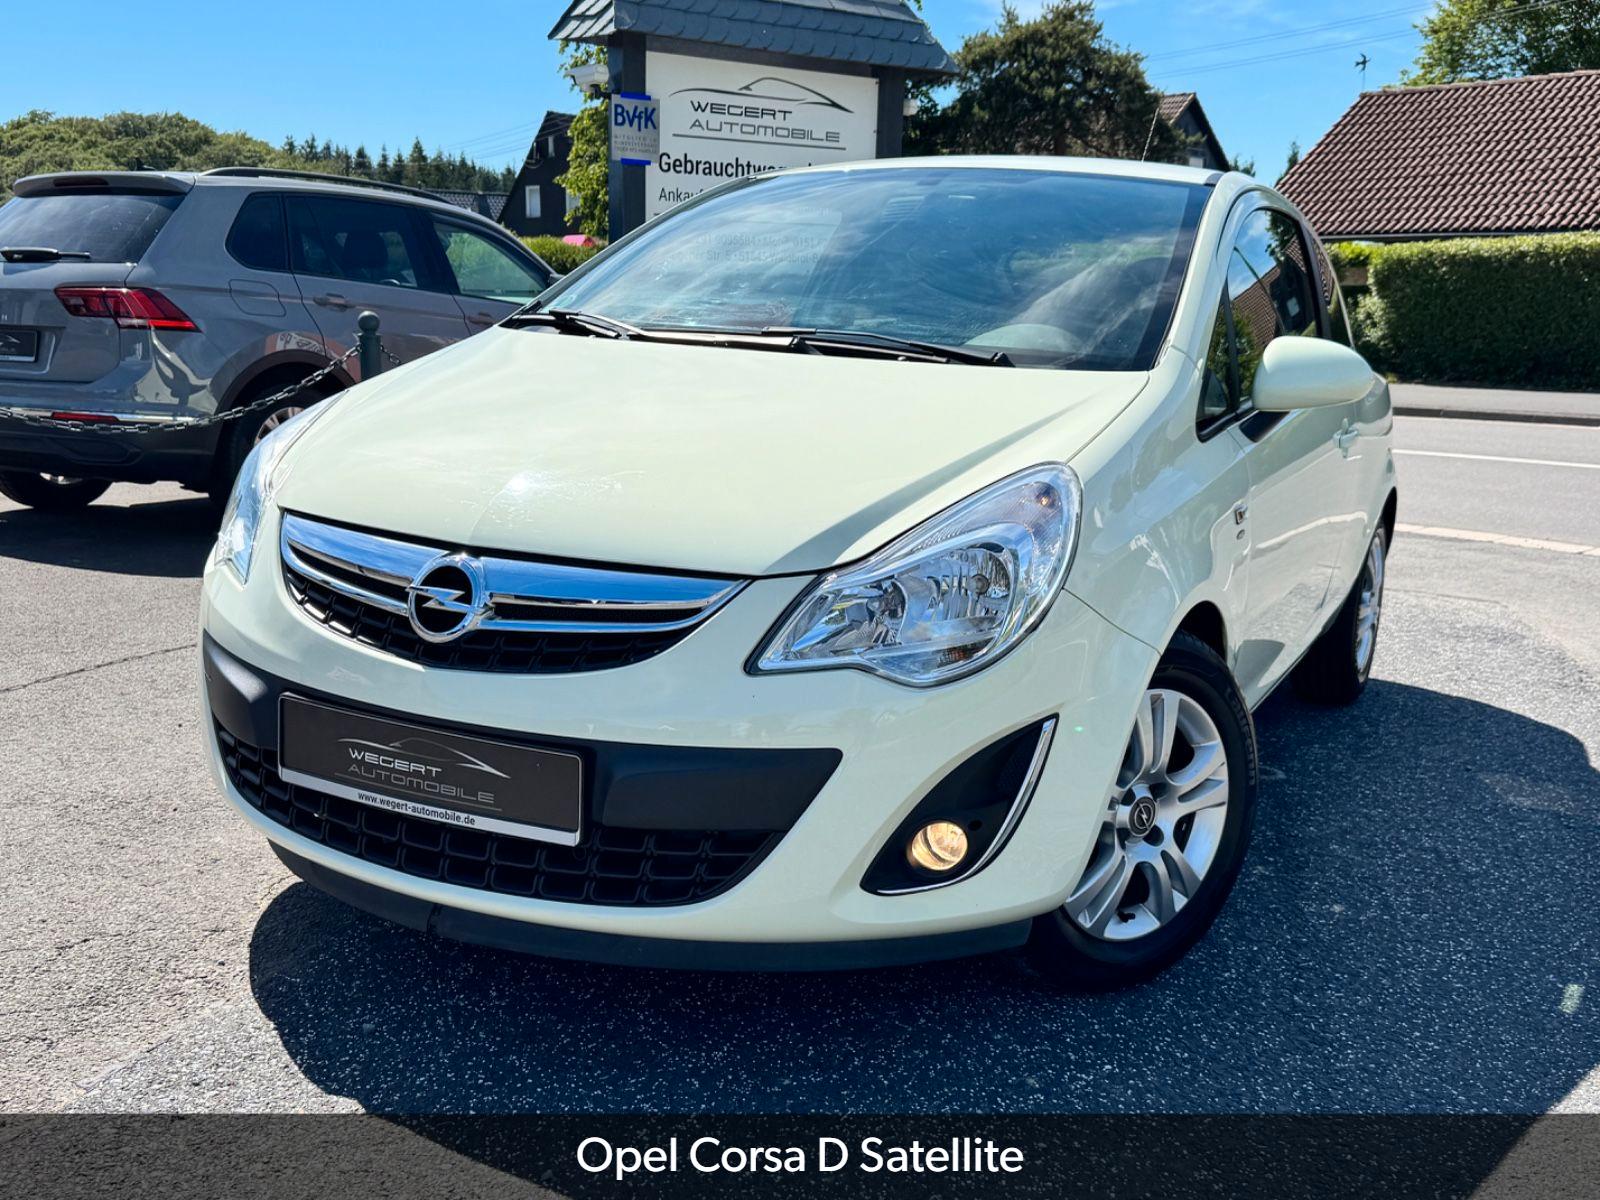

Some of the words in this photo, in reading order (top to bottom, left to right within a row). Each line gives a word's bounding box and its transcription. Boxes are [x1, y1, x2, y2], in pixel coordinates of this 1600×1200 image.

[690, 100, 792, 121] WEGERT
[689, 118, 840, 143] AUTOMOBILE
[659, 187, 704, 202] Anka
[349, 747, 442, 777] WEGERT
[348, 765, 495, 804] AUTOMOBILE
[357, 791, 476, 826] www.wegert-automobile.de
